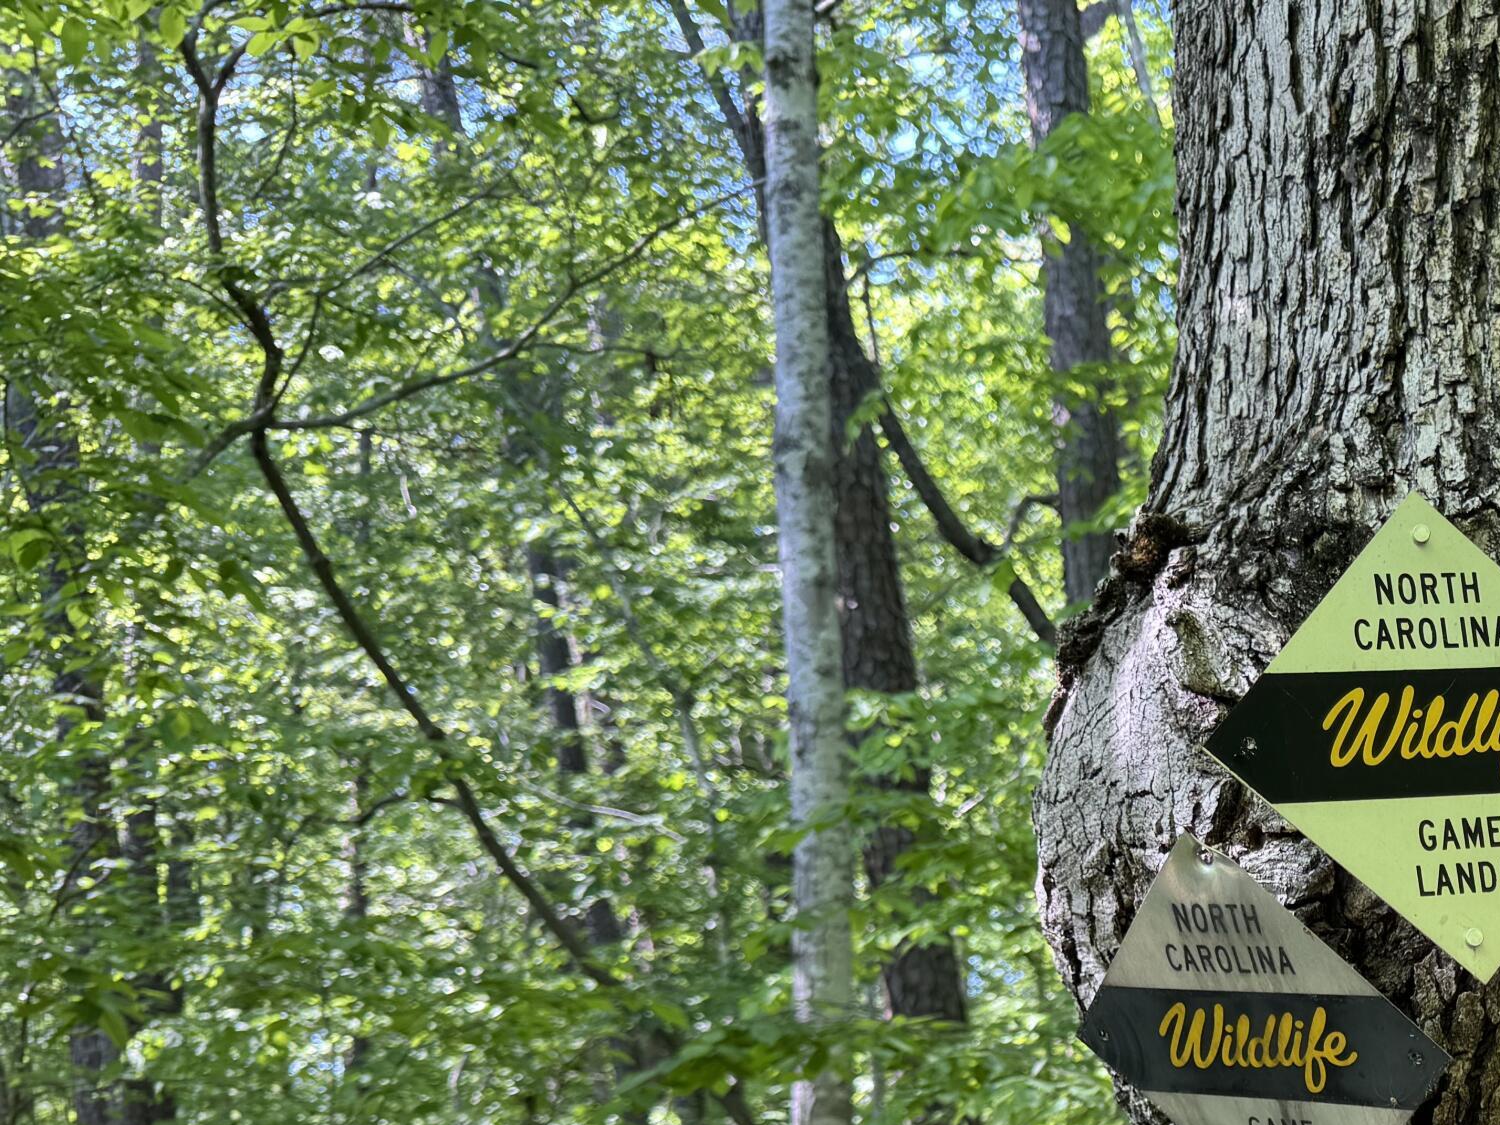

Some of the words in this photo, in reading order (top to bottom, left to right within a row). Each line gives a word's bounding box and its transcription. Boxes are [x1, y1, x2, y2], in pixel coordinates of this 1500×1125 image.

[1374, 572, 1481, 605] NORTH
[1171, 903, 1262, 936] NORTH
[1165, 944, 1296, 975] CAROLINA
[1158, 1002, 1358, 1093] Wildlife
